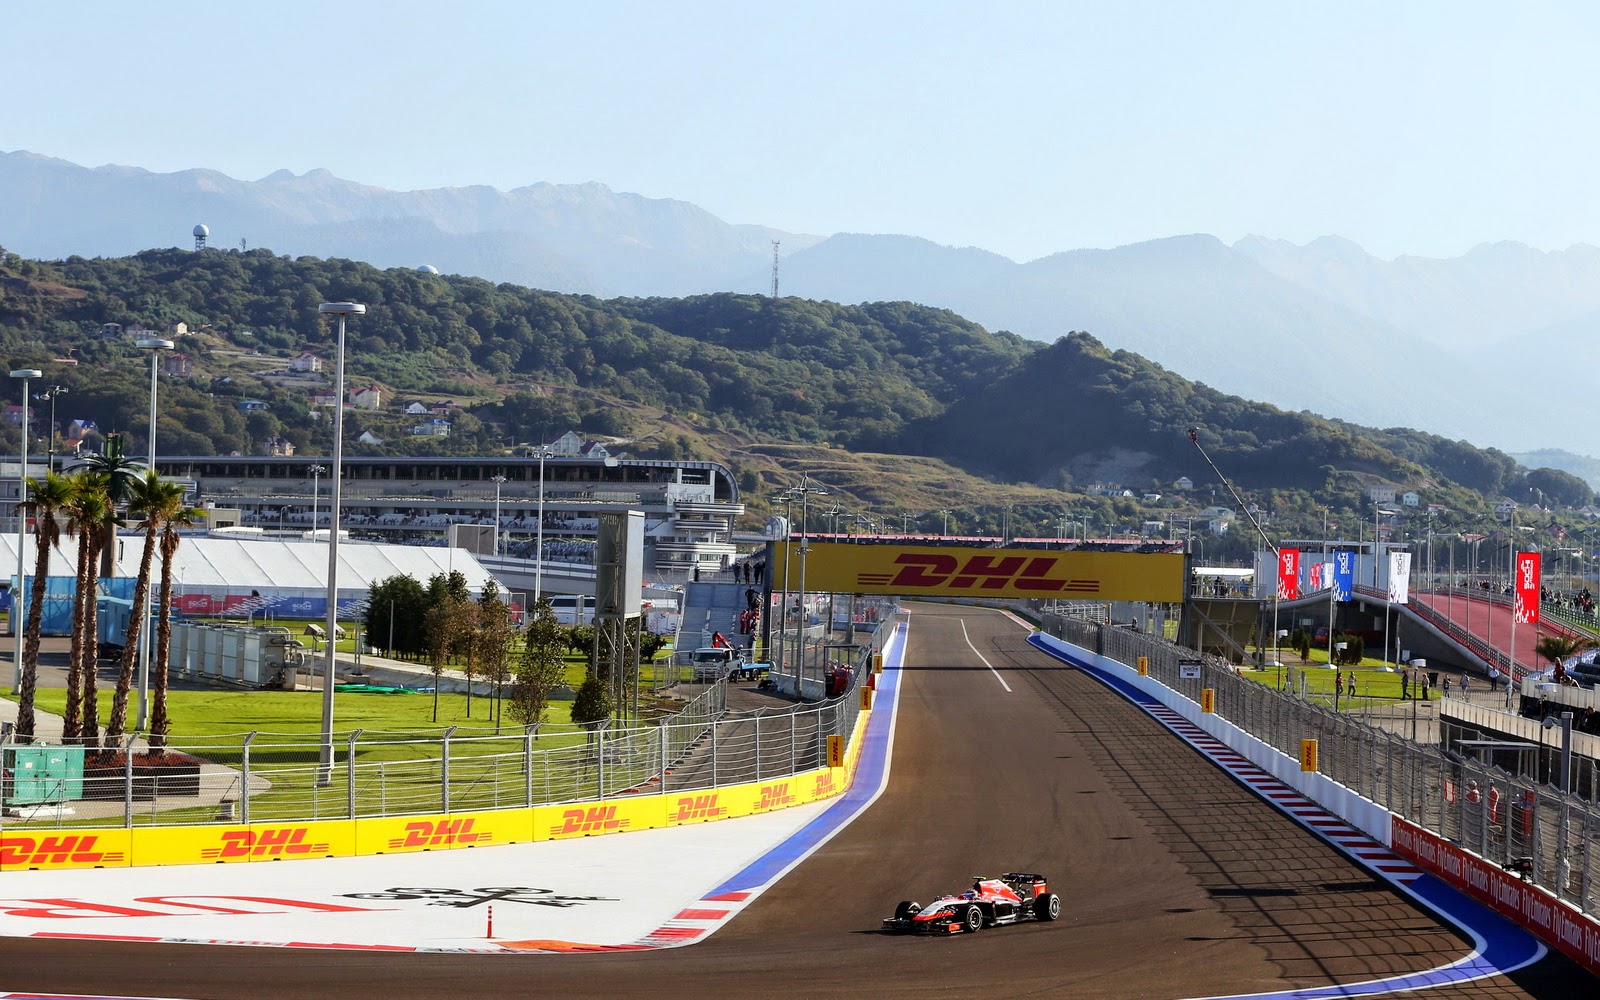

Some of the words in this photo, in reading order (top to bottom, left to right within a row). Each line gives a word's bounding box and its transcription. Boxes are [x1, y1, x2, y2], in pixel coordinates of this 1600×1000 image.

[889, 553, 1068, 590] DHL
[761, 783, 791, 809] DHL
[815, 772, 834, 796] DHL
[561, 805, 622, 834] DHL
[676, 794, 721, 821] DHL
[220, 829, 314, 858] DHL
[402, 818, 480, 847] DHL
[0, 835, 104, 865] DHL
